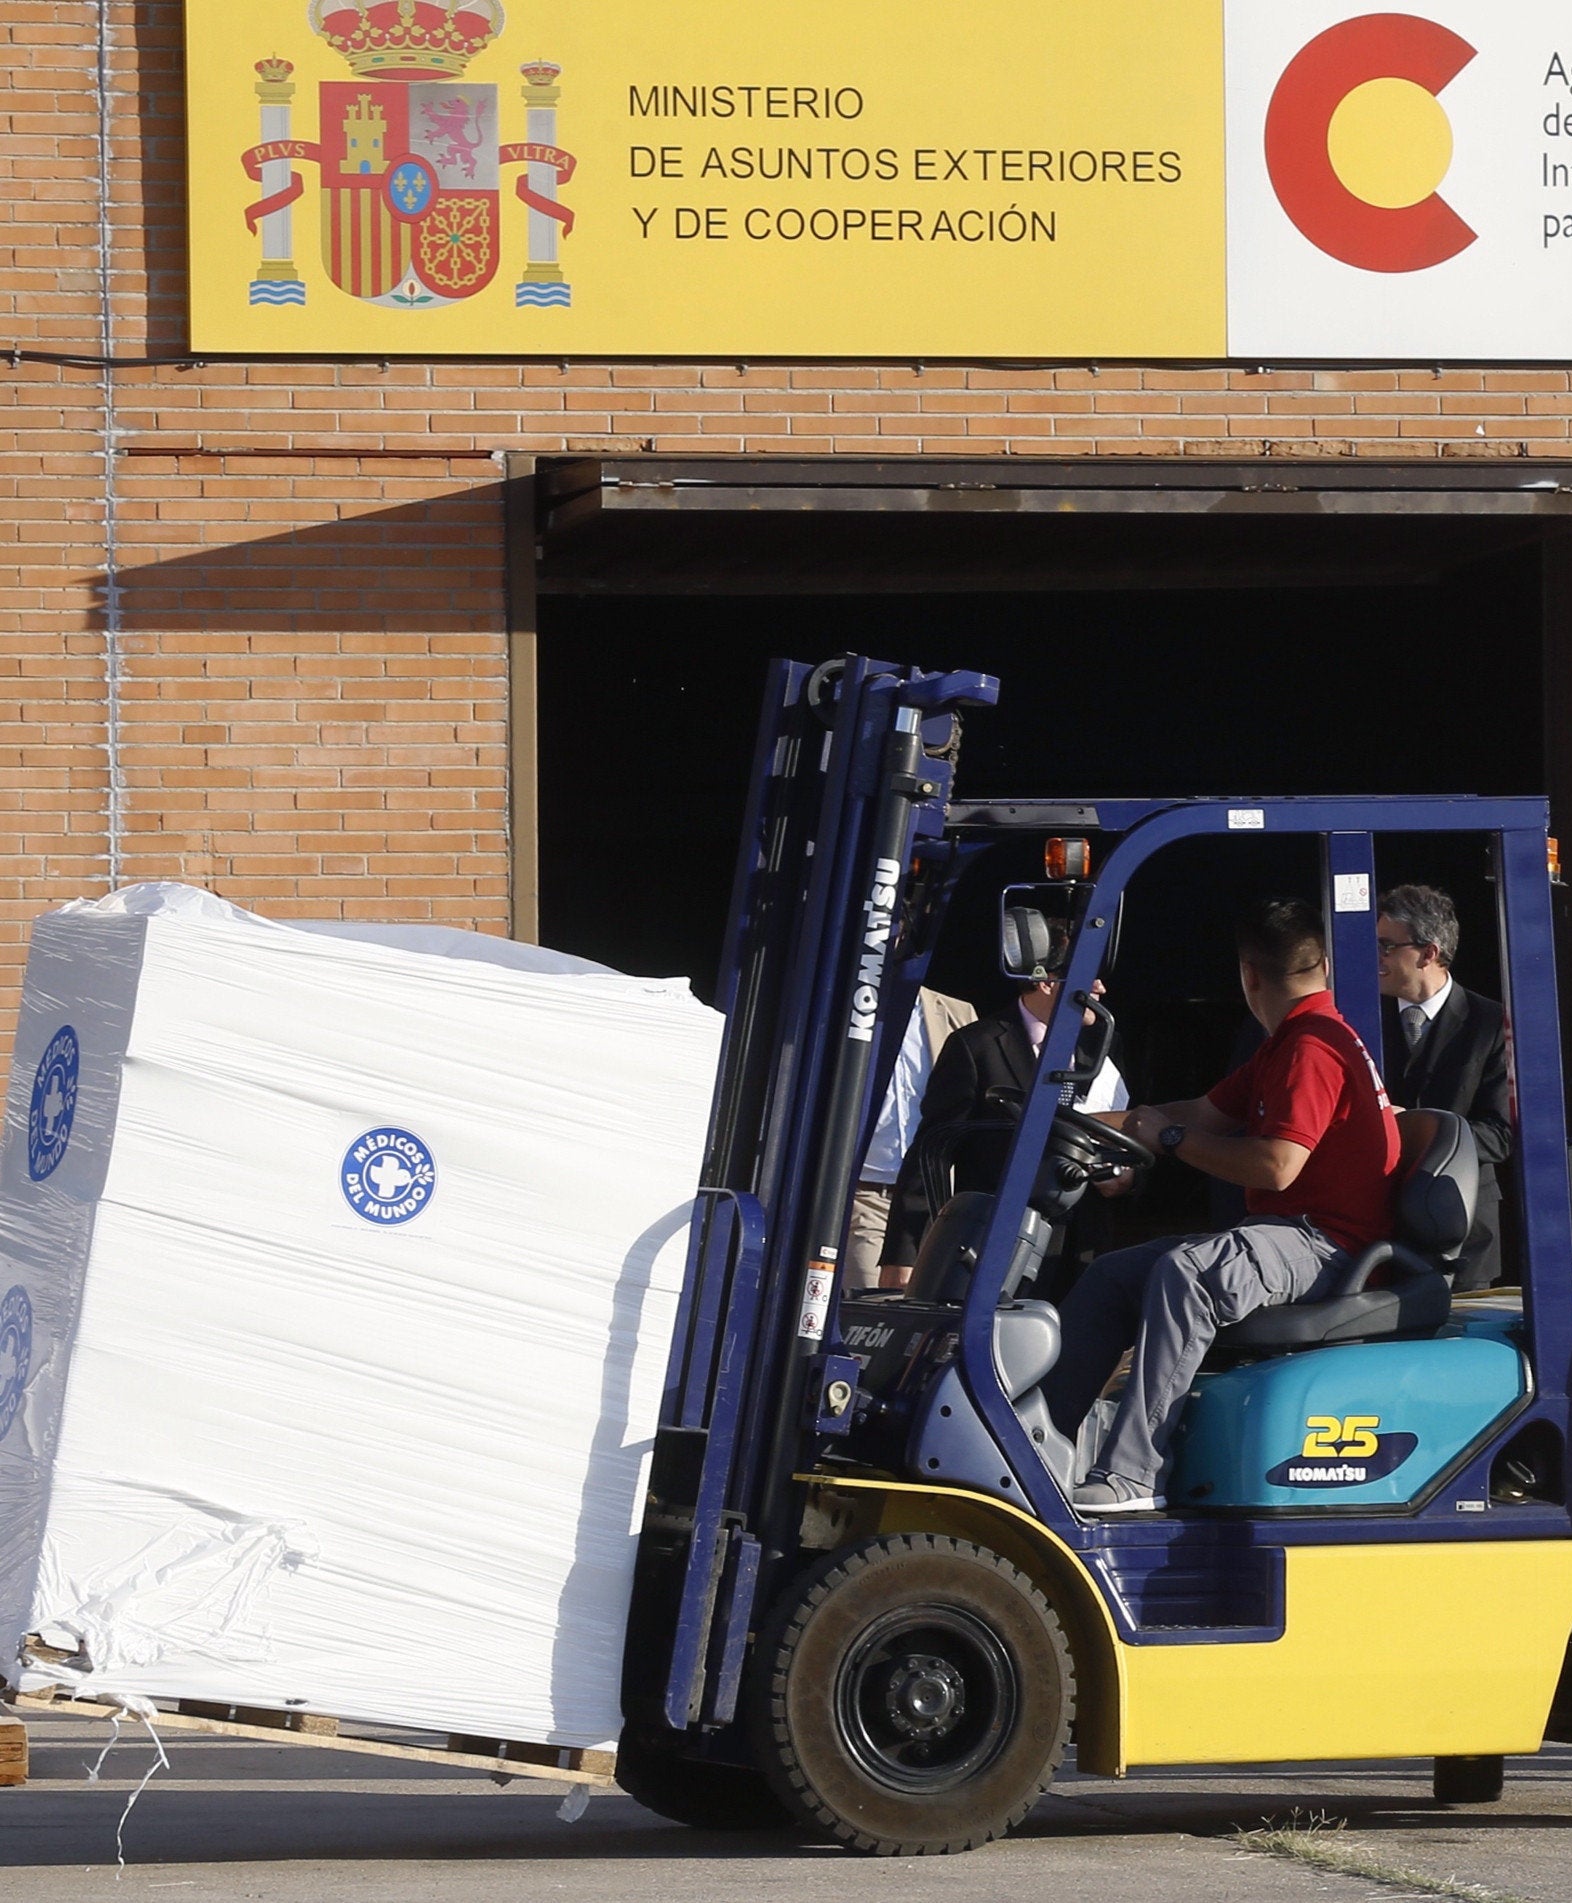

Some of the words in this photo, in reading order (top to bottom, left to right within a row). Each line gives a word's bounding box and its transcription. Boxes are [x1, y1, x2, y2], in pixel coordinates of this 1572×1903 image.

[628, 85, 864, 120] MINISTERIO
[252, 142, 306, 163] PLVS
[507, 145, 571, 170] VLTRA
[630, 146, 685, 179] DE
[700, 147, 900, 180] ASUNTOS
[914, 149, 1182, 183] EXTERIORES
[632, 206, 659, 240] Y
[674, 207, 729, 240] DE
[744, 202, 1057, 242] COOPERACIÓN
[847, 857, 901, 1043] KOMATSU
[352, 1134, 425, 1165] MÉDICOS
[346, 1172, 365, 1205] DEL
[364, 1186, 427, 1220] MUNDO
[842, 1321, 896, 1349] TIFÓN
[1301, 1415, 1381, 1459] 25
[1288, 1462, 1367, 1483] KOMATSU
